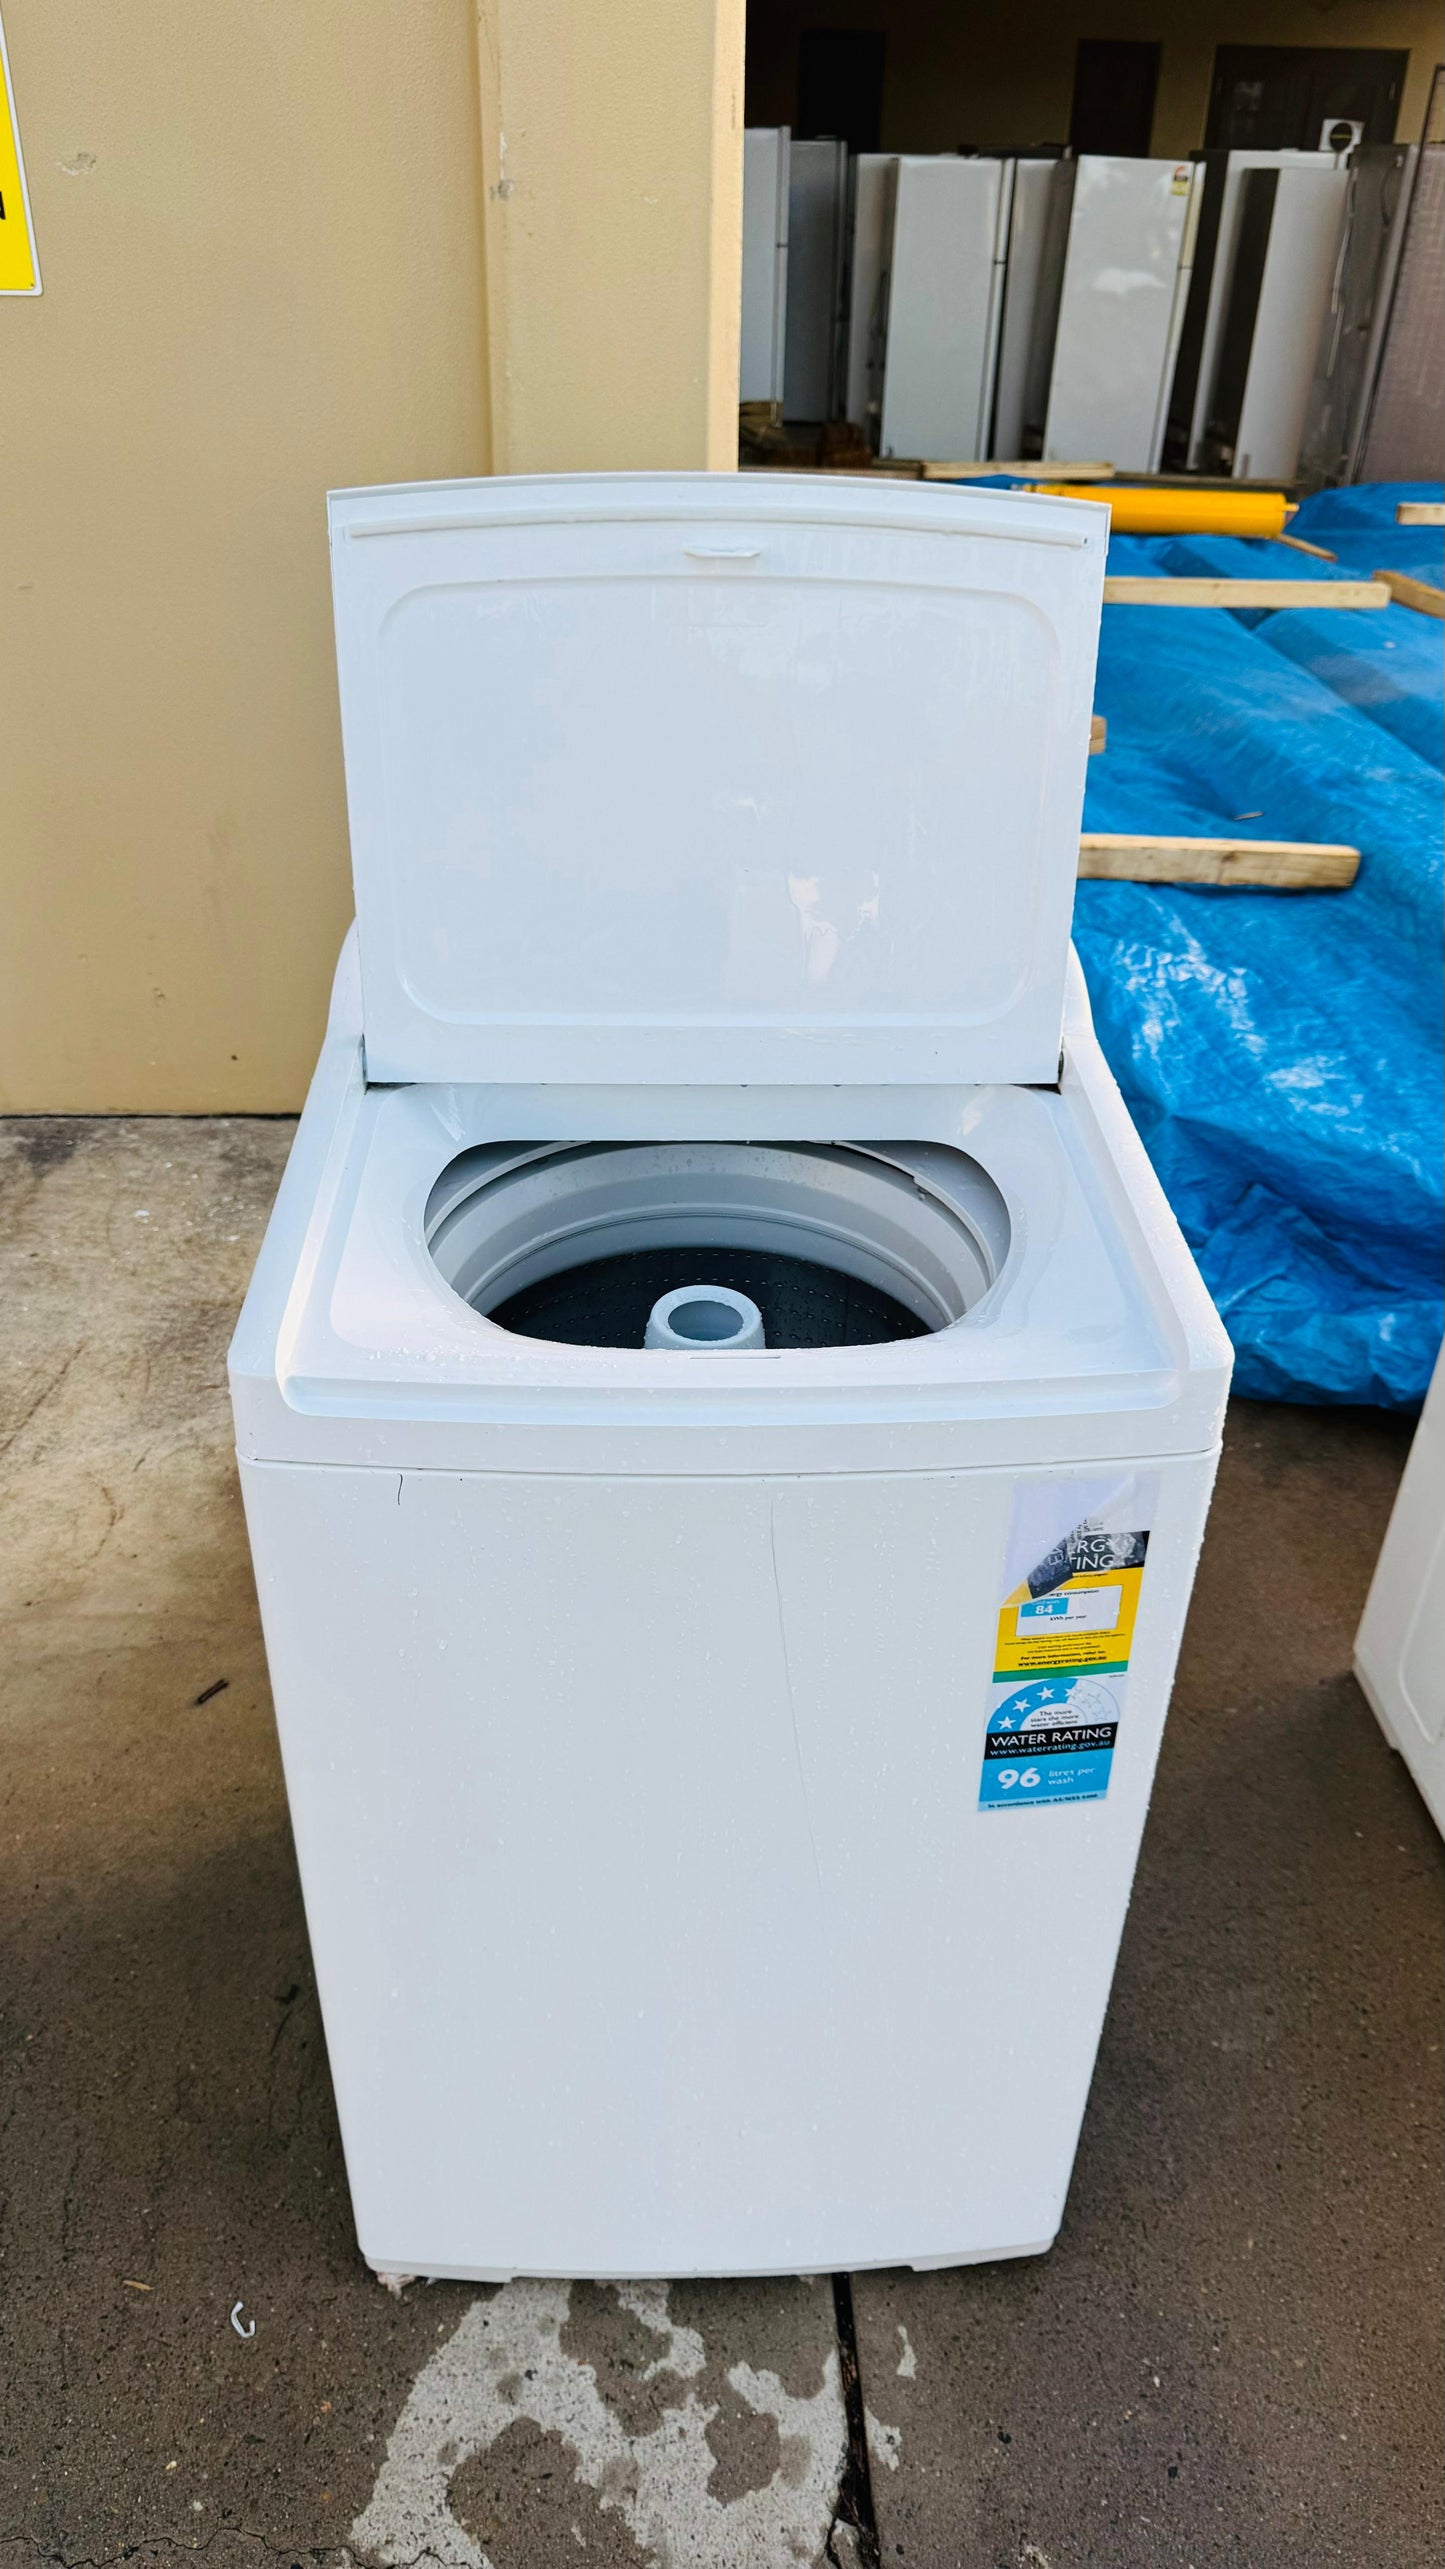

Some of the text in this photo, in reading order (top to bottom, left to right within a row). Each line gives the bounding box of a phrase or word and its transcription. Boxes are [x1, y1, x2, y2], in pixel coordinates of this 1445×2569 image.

[1035, 1604, 1053, 1615] 84
[991, 1727, 1111, 1747] WATER RATING
[990, 1740, 1110, 1756] www.waterrating.gov.au
[997, 1767, 1096, 1789] 96 litres per
[1047, 1777, 1074, 1785] wash
